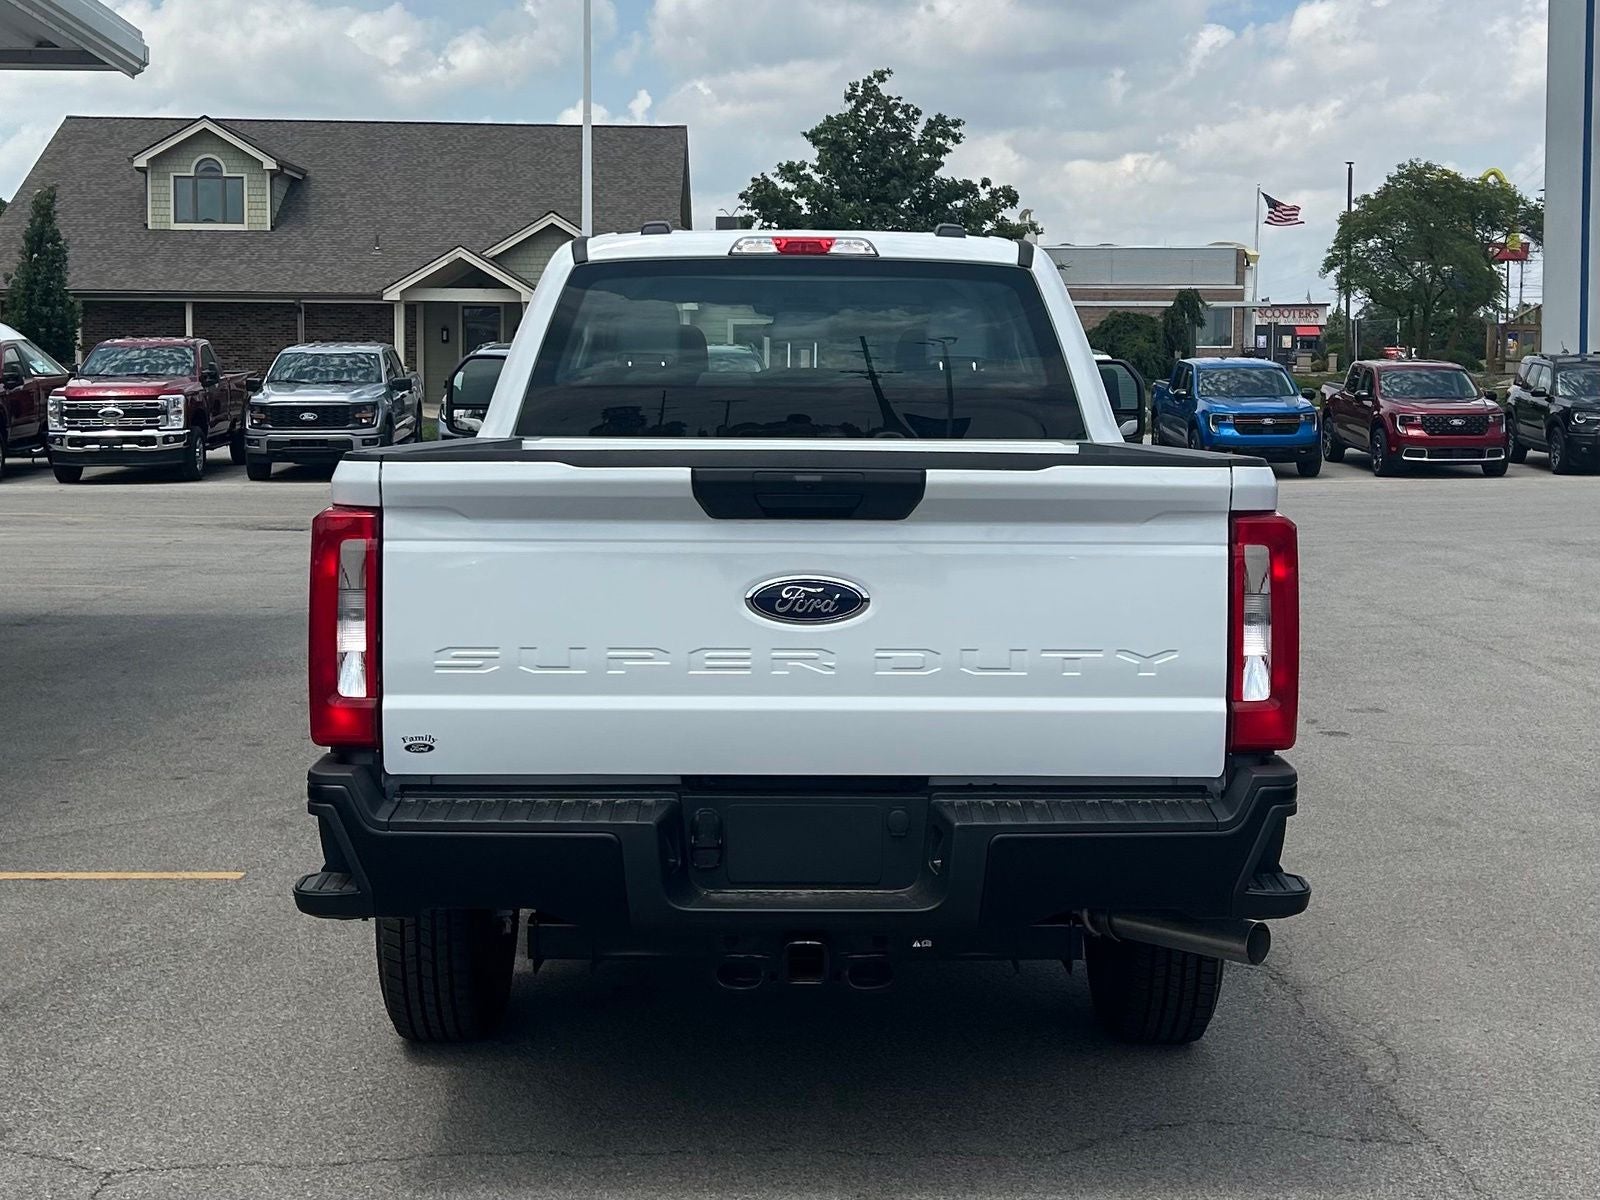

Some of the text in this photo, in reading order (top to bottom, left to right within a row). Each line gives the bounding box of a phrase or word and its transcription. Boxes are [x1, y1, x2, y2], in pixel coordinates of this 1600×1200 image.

[774, 585, 841, 613] Ford
[434, 646, 1179, 676] SUPER DUTY
[401, 734, 436, 744] Family
